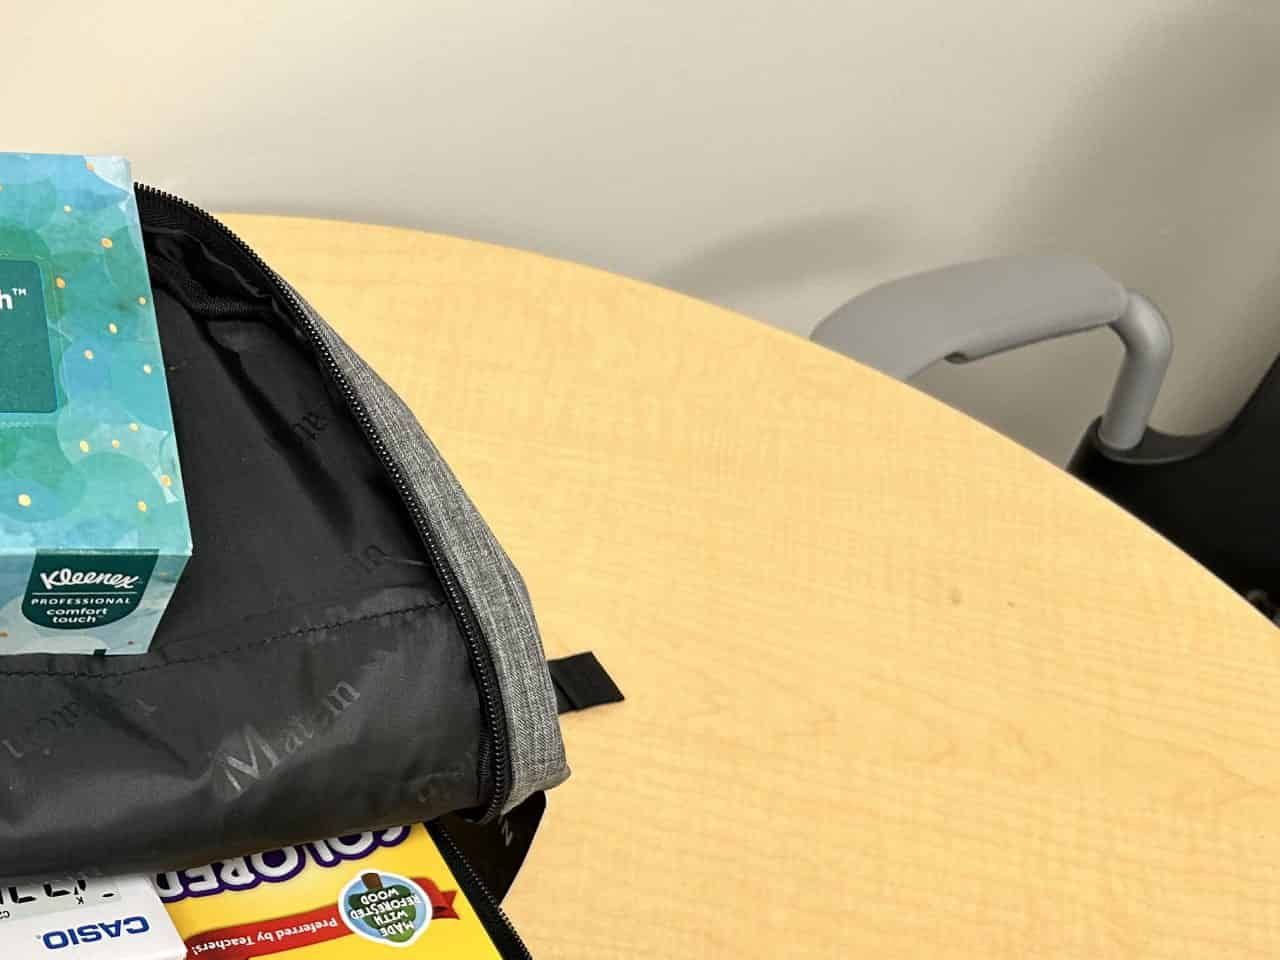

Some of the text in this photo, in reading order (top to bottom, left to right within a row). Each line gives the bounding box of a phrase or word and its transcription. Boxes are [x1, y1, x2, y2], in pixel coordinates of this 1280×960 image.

[40, 567, 140, 590] Kleenex
[31, 597, 131, 606] PROFESSIONAL
[46, 606, 108, 616] comfort
[222, 679, 361, 792] Matn
[361, 887, 399, 905] WOOD
[350, 894, 422, 920] REFORESTED
[375, 909, 408, 927] WITH
[42, 916, 150, 950] CASIO
[190, 918, 339, 957] Preferred by Teachers!
[381, 920, 414, 938] MADE
